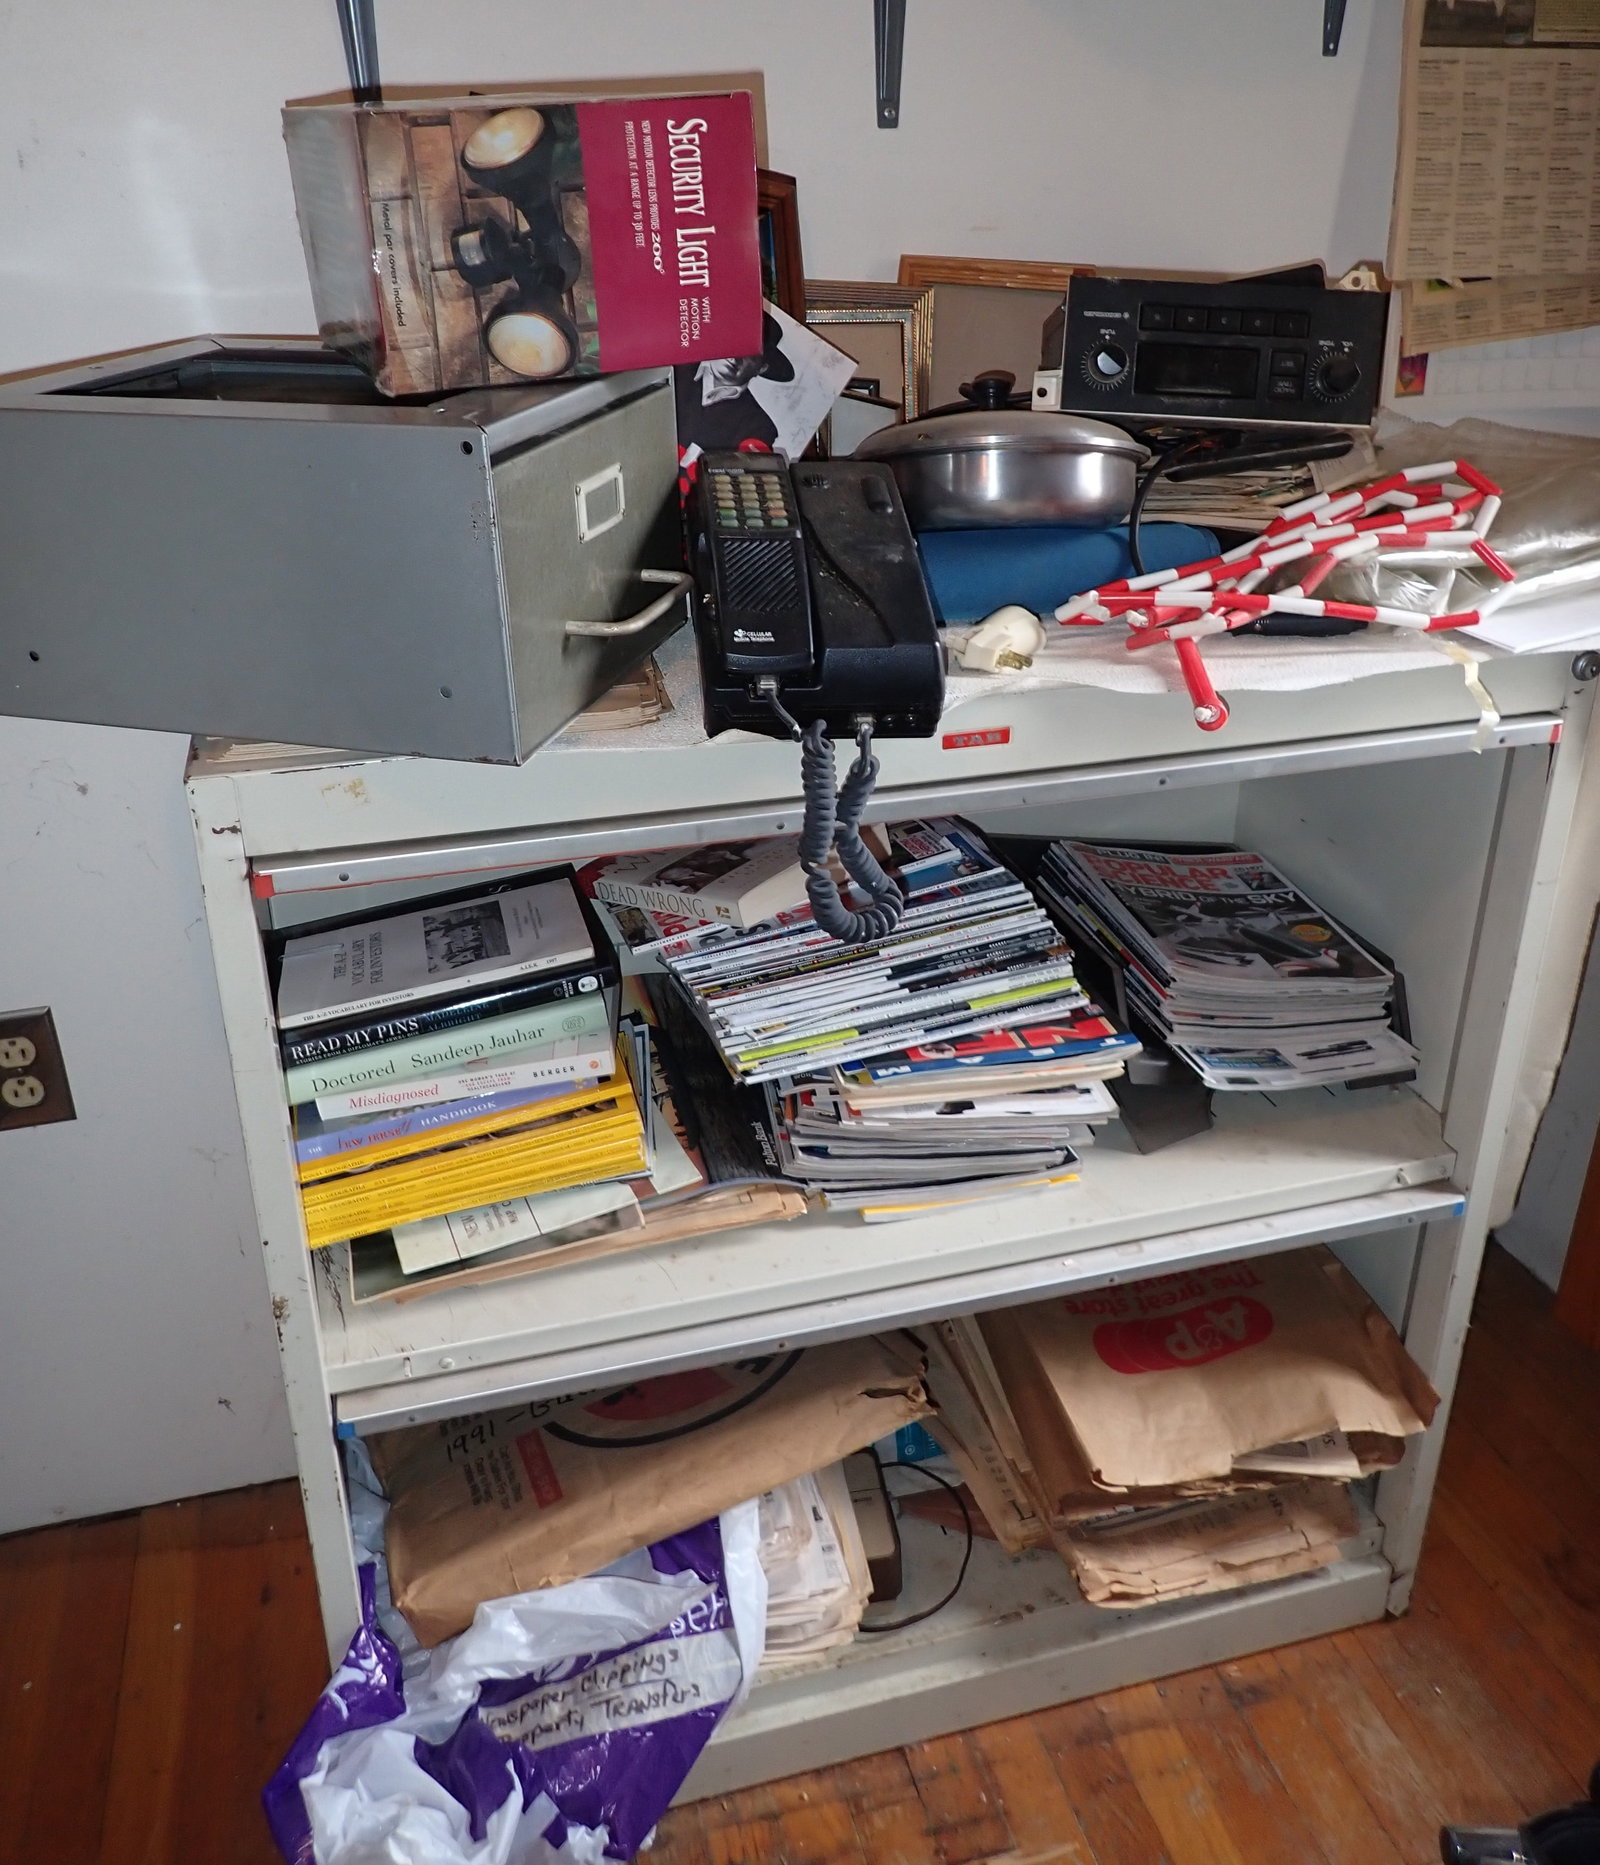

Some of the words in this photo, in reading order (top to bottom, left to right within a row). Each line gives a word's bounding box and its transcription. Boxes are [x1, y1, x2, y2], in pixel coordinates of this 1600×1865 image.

[624, 120, 637, 159] PROTECTION
[641, 120, 651, 134] NEW
[643, 135, 654, 158] MOTION
[629, 160, 638, 170] AT
[645, 159, 656, 188] DETECTOR
[666, 118, 708, 217] SECURITY
[630, 178, 641, 199] RANGE
[648, 189, 658, 203] LENS
[381, 203, 392, 231] Metal
[632, 200, 641, 209] UP
[633, 211, 642, 220] TO
[649, 203, 660, 230] PROVIDES
[384, 233, 393, 251] par
[389, 255, 398, 285] covers
[676, 225, 716, 288] LIGHT
[393, 287, 406, 327] included
[691, 297, 701, 340] MOTION
[702, 296, 711, 323] WITH
[679, 298, 689, 347] DETECTOR
[598, 882, 638, 905] DEAD
[640, 889, 705, 918] WRONG
[1247, 892, 1297, 905] SKY
[291, 1037, 341, 1060] READ
[345, 1028, 371, 1047] MY
[377, 1017, 419, 1040] PINS
[312, 1060, 396, 1093] Doctored
[411, 1043, 485, 1068] Sandeep
[489, 1026, 546, 1050] Jauhar
[533, 1066, 576, 1078] BERGER
[350, 1084, 440, 1109] Misdiagnosed
[420, 1101, 497, 1127] HANDBOOK
[750, 1120, 768, 1141] Bank
[761, 1141, 779, 1167] Fulton
[1212, 1266, 1265, 1288] The
[1065, 1298, 1130, 1317] store
[1136, 1279, 1207, 1314] great
[1164, 1300, 1250, 1361] A&P
[446, 1419, 496, 1464] 1991
